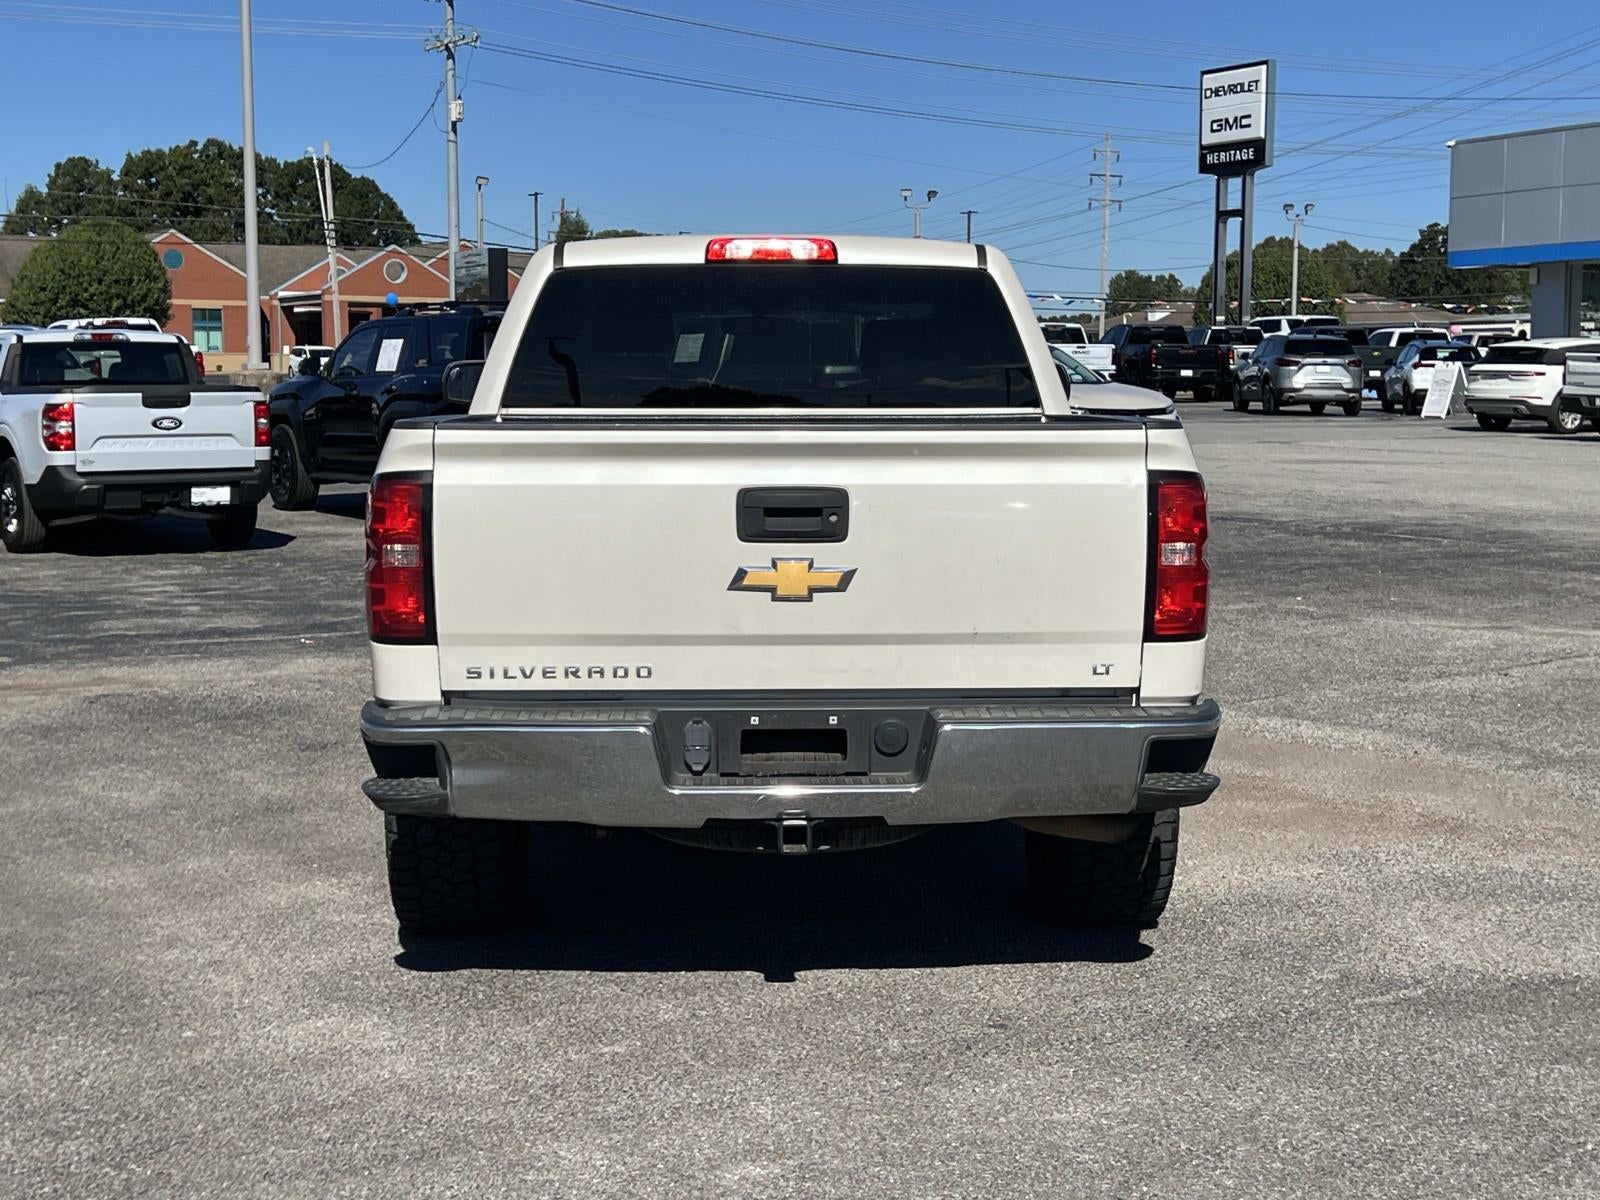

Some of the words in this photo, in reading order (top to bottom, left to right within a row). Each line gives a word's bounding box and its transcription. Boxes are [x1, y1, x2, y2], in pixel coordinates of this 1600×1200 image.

[1204, 79, 1260, 99] CHEVROLET
[1210, 114, 1252, 133] GMC
[1207, 148, 1254, 164] HERITAGE
[99, 439, 232, 449] MAVERICK
[465, 666, 652, 680] SILVERADO
[1092, 663, 1114, 676] LT
